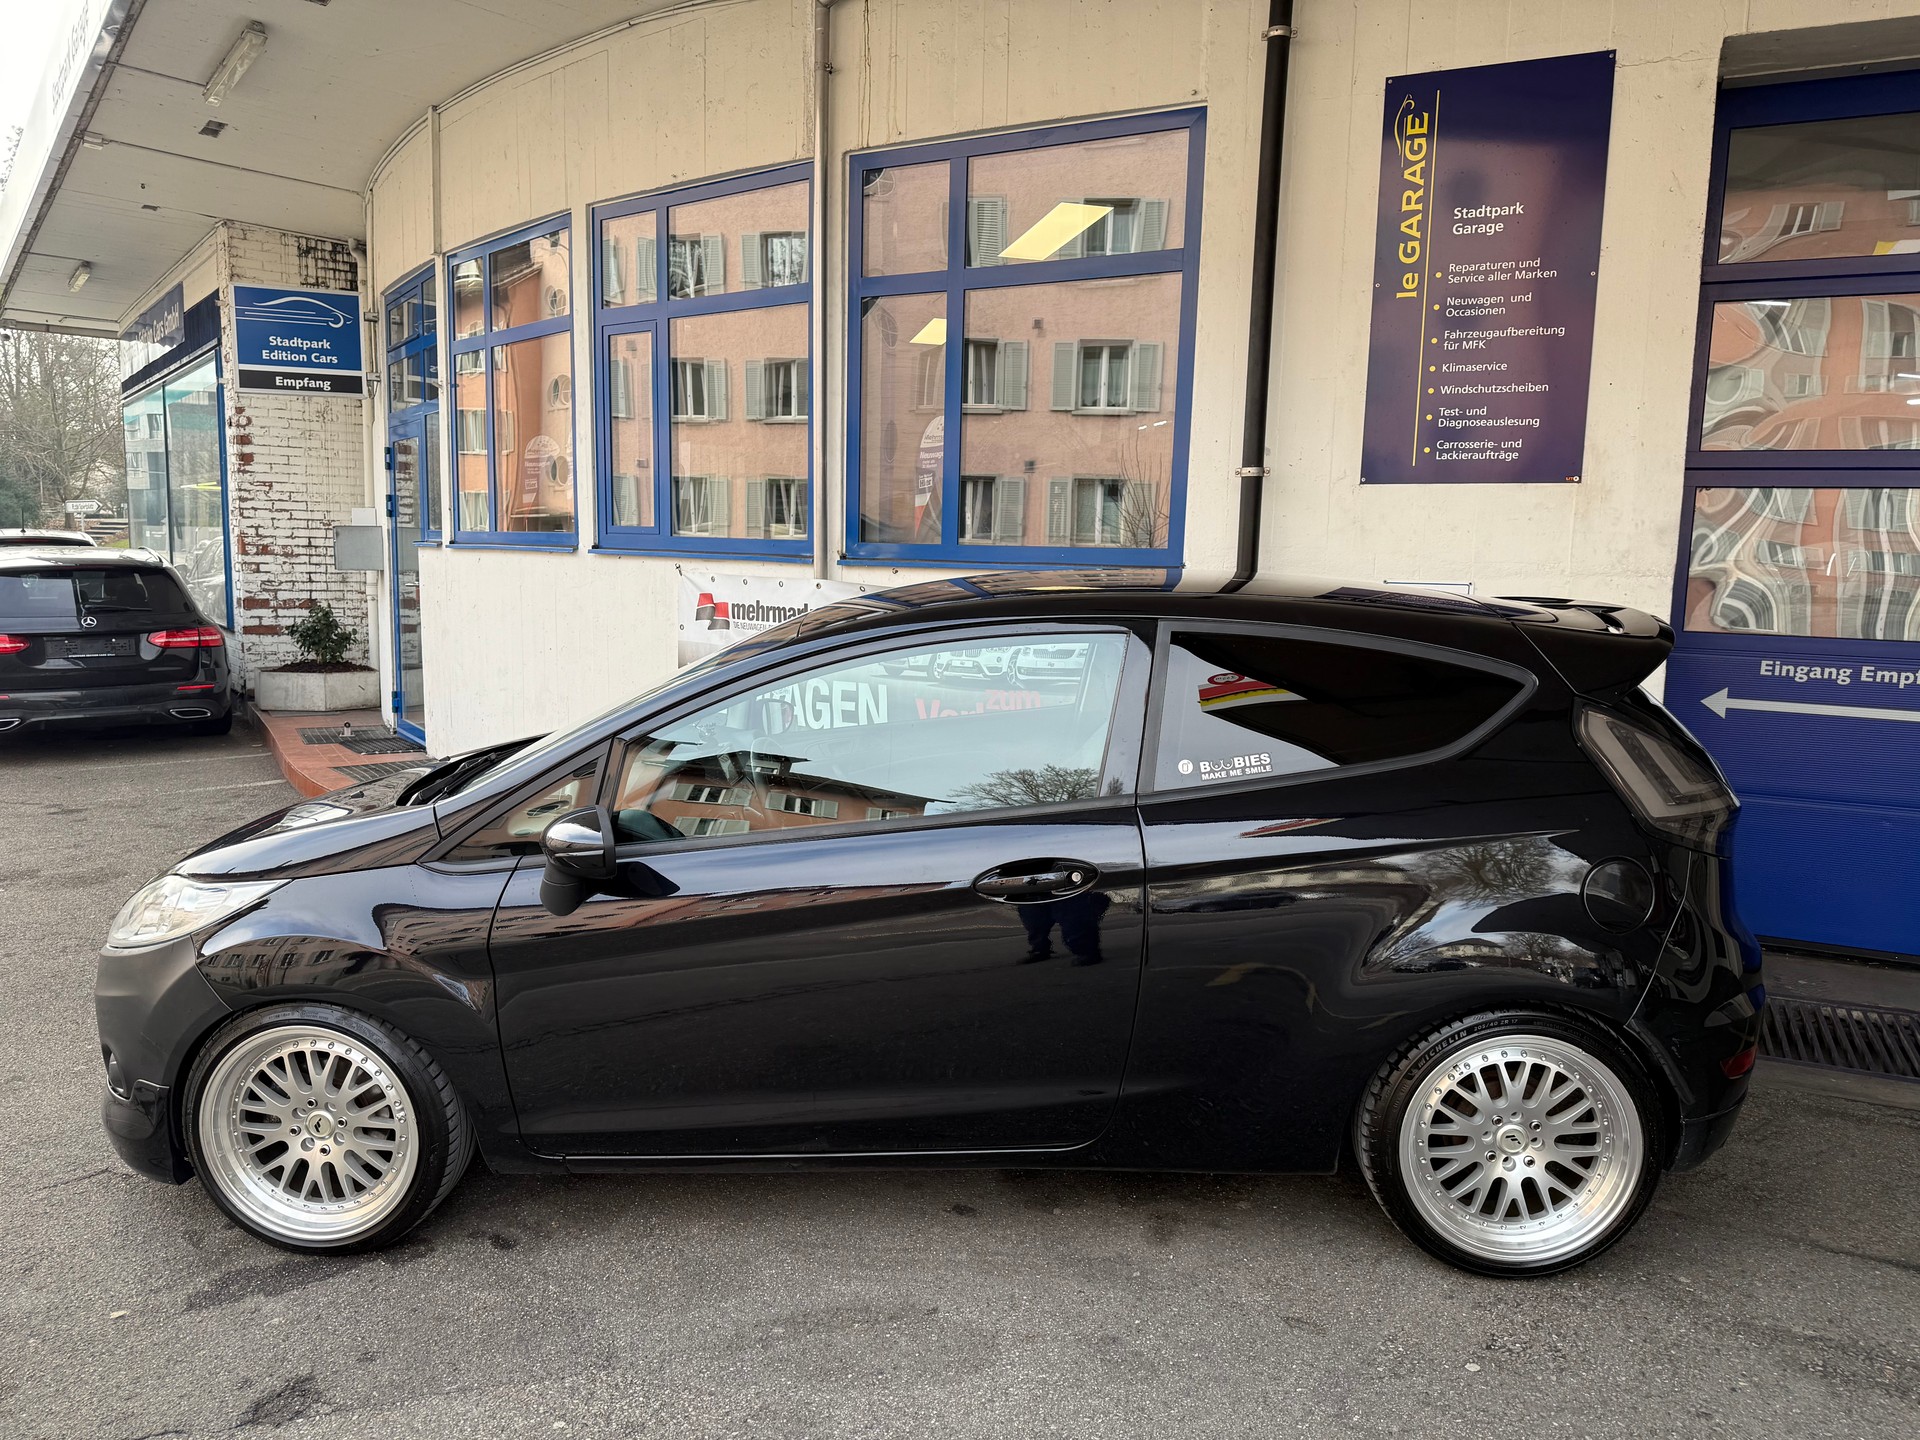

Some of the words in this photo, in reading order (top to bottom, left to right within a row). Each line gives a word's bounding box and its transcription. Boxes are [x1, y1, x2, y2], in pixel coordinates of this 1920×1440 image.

[1398, 112, 1428, 264] GARAGE
[1453, 202, 1524, 219] Stadtpark
[1452, 222, 1504, 235] Garage
[1449, 260, 1515, 273] Reparaturen
[1519, 258, 1541, 268] und
[1448, 273, 1485, 284] Service
[1487, 271, 1511, 281] aller
[1514, 269, 1557, 280] Marken
[1396, 272, 1418, 298] le
[1446, 295, 1504, 306] Neuwagen
[1511, 292, 1532, 303] und
[1446, 307, 1506, 317] Occasionen
[1444, 326, 1565, 340] Fahrzeugaufbereitung
[269, 336, 331, 350] Stadtpark
[1443, 341, 1458, 351] für
[1462, 340, 1486, 349] MFK
[262, 350, 307, 362] Edition
[311, 353, 338, 364] Cars
[1442, 362, 1508, 372] Klimaservice
[275, 376, 331, 391] Empfang
[1440, 383, 1549, 394] Windschutzscheiben
[1439, 407, 1463, 416] Test-
[1466, 406, 1487, 416] und
[1438, 417, 1540, 429] Diagnoseauslesung
[1436, 439, 1498, 449] Carrosserie-
[1501, 438, 1522, 449] und
[1436, 450, 1519, 461] Lackieraufträge
[1760, 660, 1852, 685] Eingang
[1202, 772, 1227, 781] MAKE
[1230, 769, 1243, 777] ME
[1245, 765, 1272, 775] SMILE
[1418, 1030, 1467, 1068] MICHELIN
